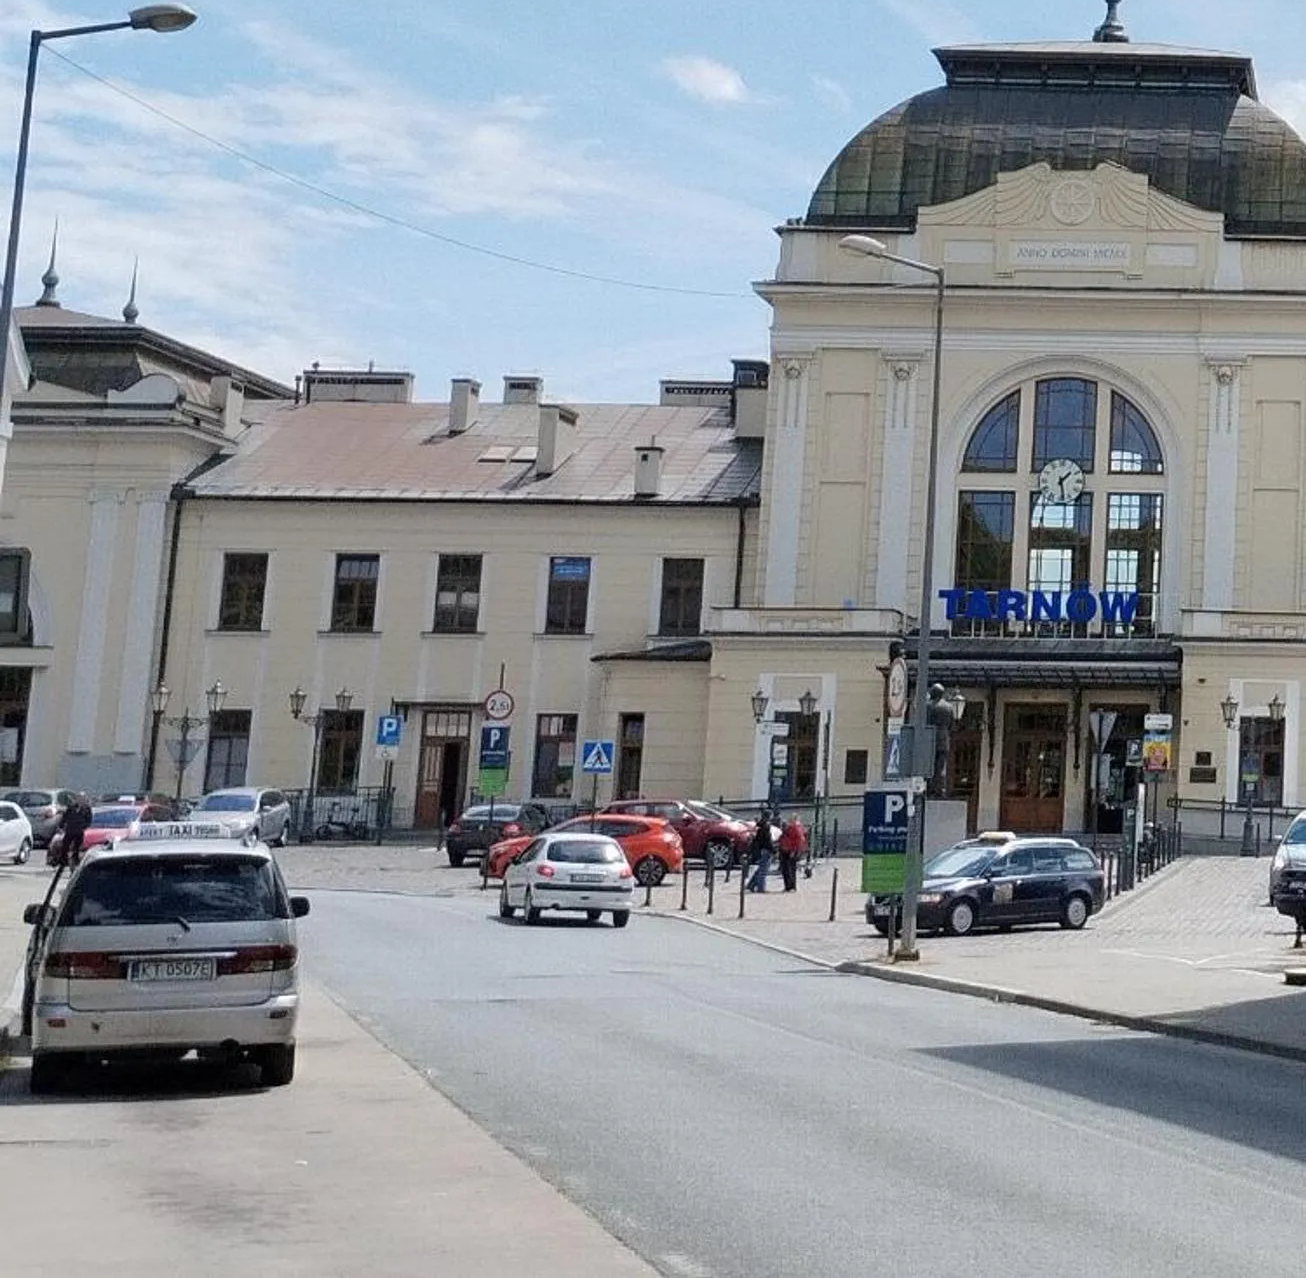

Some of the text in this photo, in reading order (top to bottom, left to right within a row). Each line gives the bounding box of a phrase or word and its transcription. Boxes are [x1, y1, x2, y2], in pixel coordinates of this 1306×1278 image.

[939, 579, 1139, 624] TARNÓW
[382, 719, 397, 736] P
[489, 728, 501, 748] P
[884, 795, 904, 822] P
[168, 824, 192, 835] TAXI
